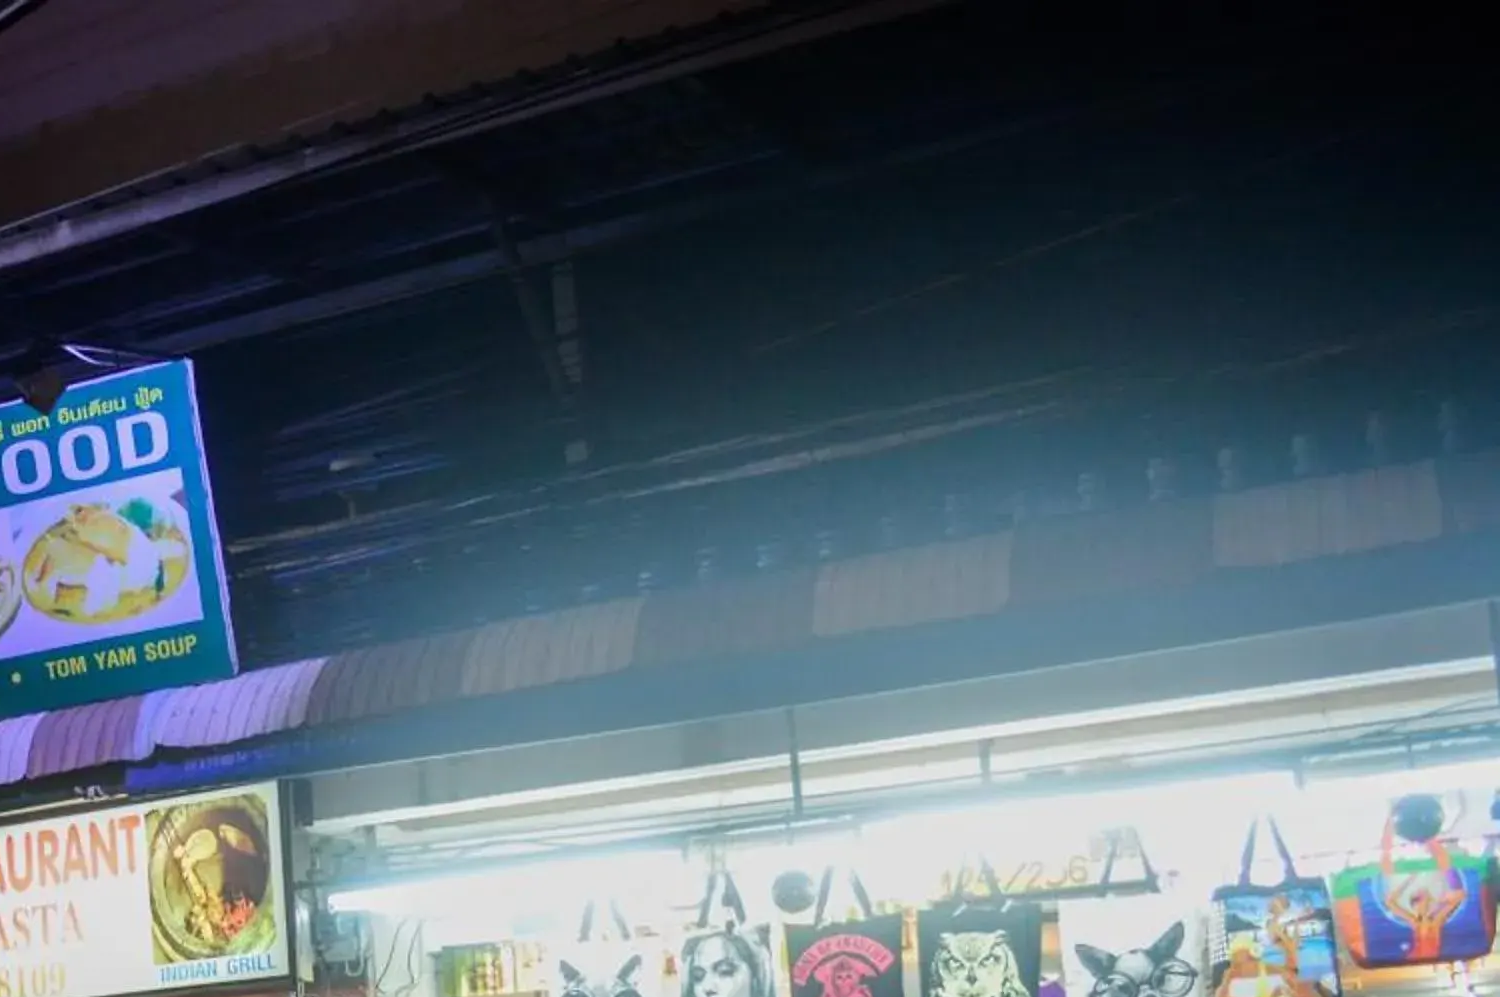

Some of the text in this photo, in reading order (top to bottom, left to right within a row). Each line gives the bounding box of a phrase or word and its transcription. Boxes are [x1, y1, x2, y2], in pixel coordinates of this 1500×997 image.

[44, 656, 86, 681] TOM
[93, 646, 136, 671] YAM
[144, 634, 197, 662] SOUP
[160, 953, 277, 984] INDIAN GRILL
